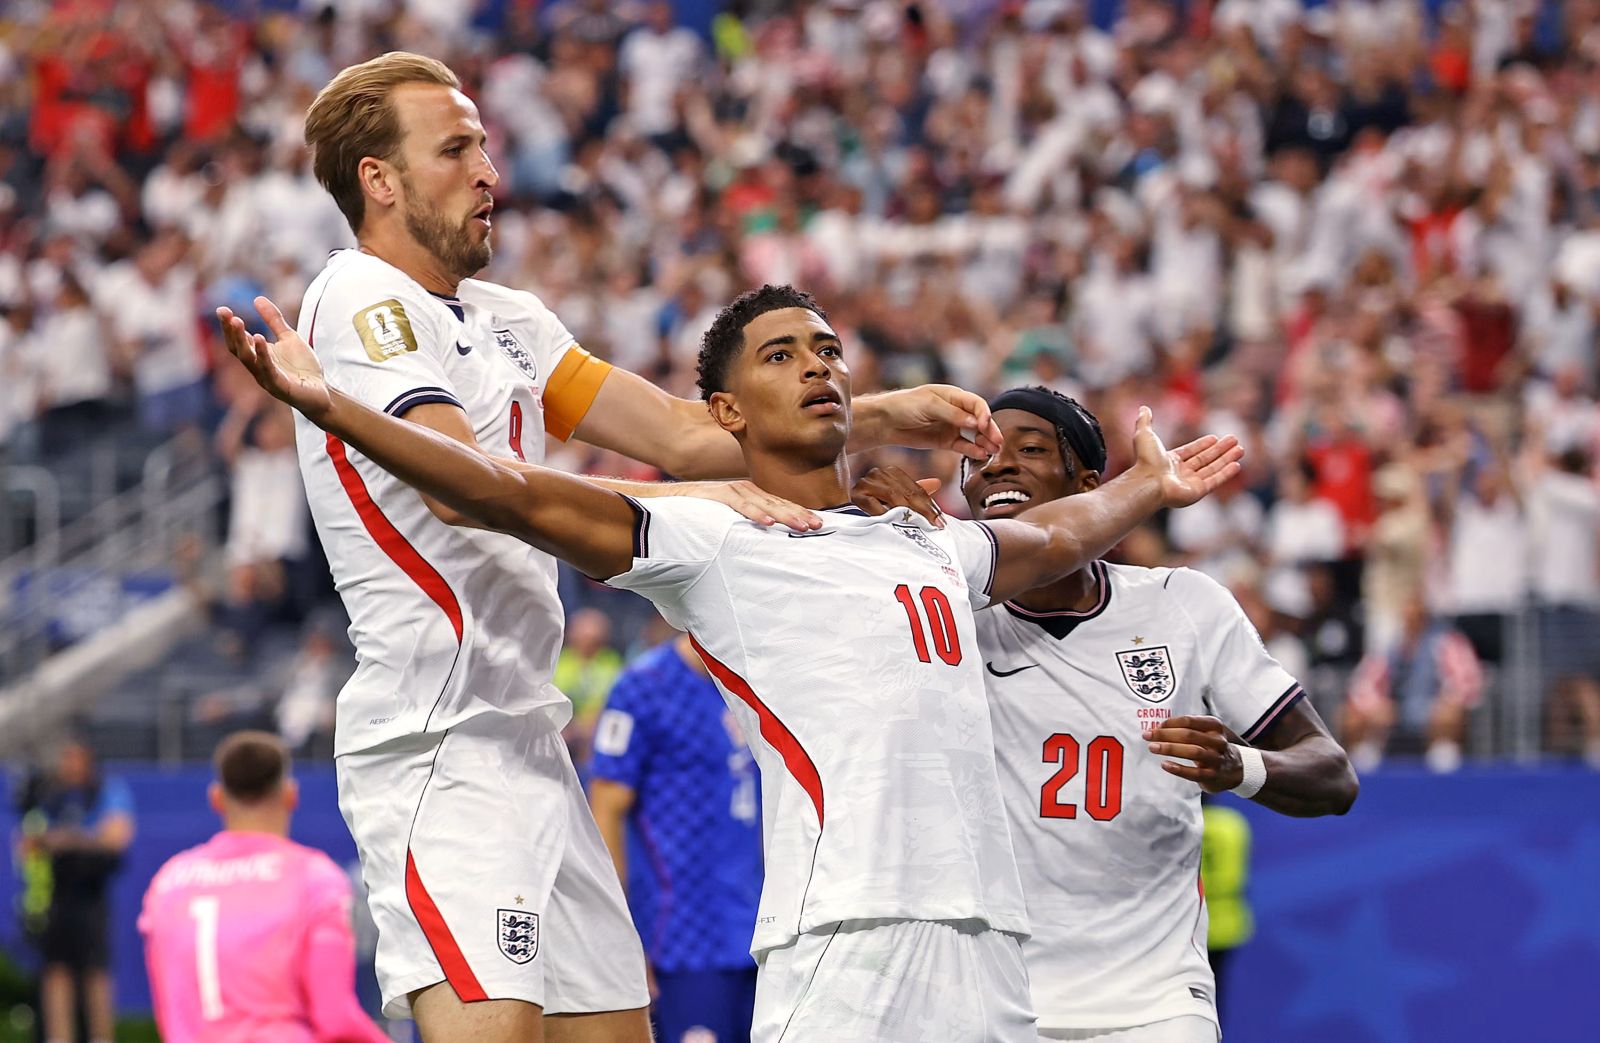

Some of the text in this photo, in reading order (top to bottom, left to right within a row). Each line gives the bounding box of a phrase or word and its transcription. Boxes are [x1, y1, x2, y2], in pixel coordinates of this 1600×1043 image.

[508, 400, 527, 463] 9
[894, 584, 963, 667] 10
[1040, 732, 1125, 822] 20
[189, 896, 225, 1022] 1
